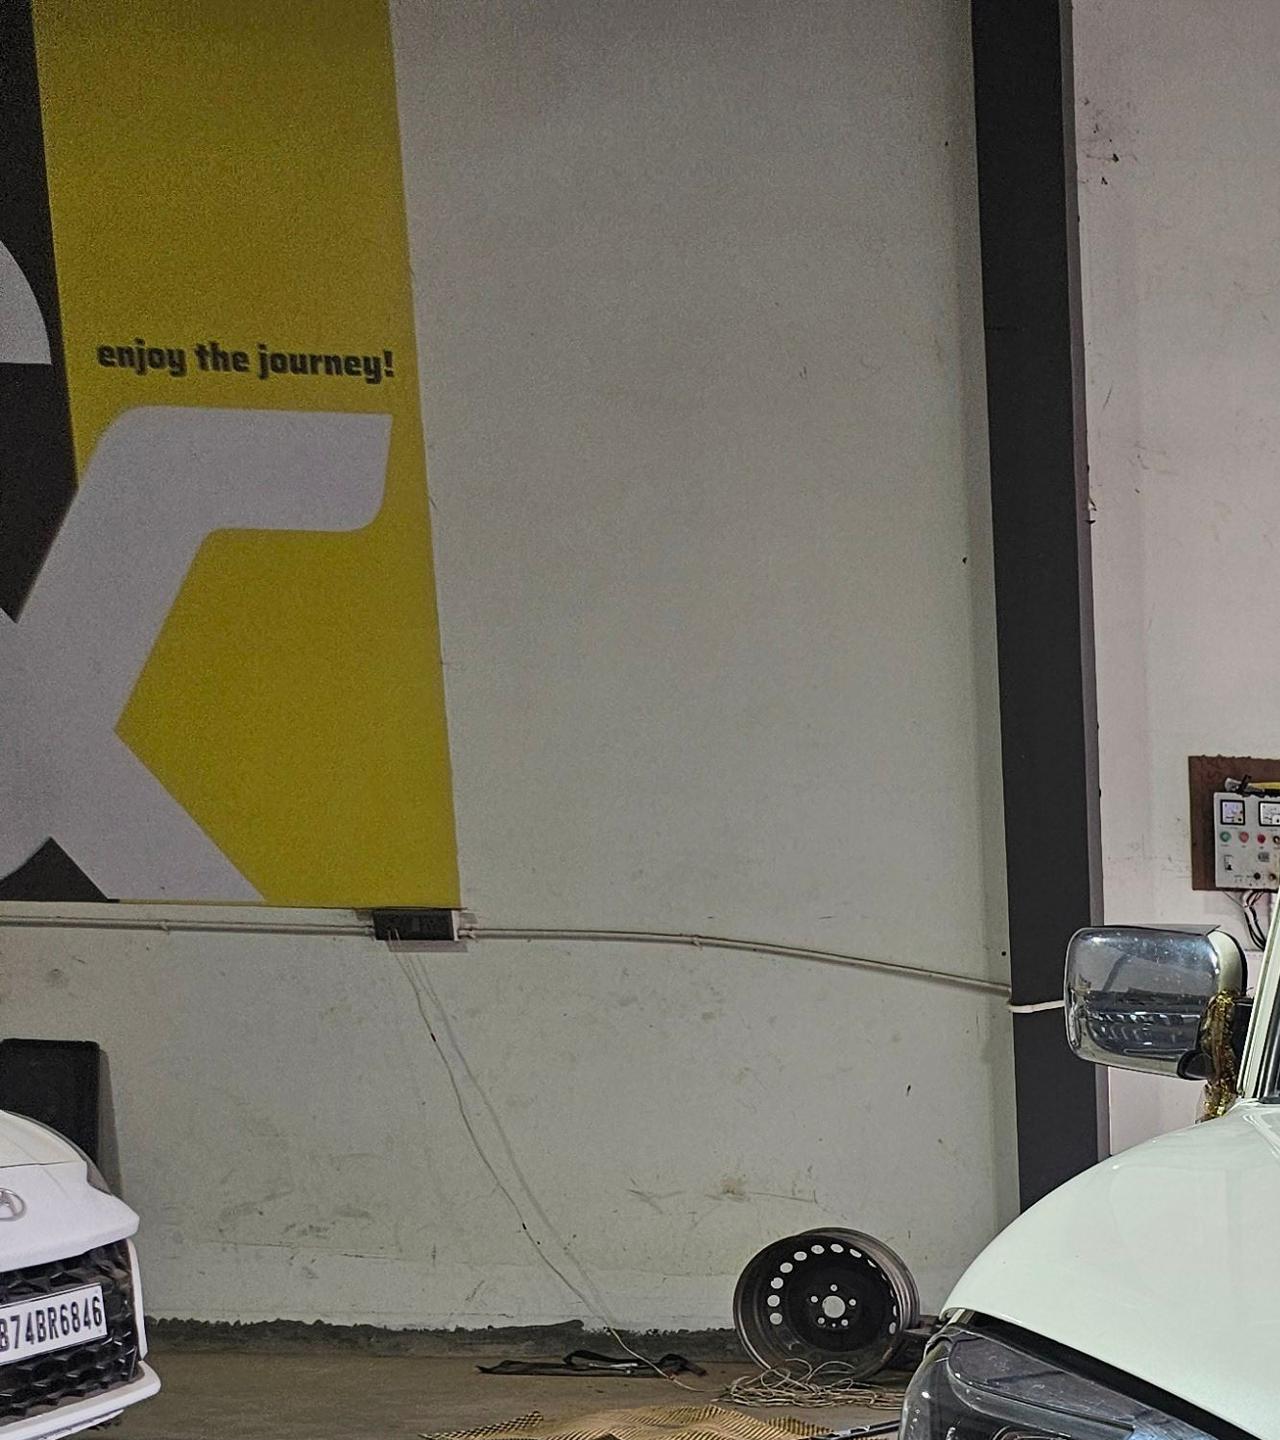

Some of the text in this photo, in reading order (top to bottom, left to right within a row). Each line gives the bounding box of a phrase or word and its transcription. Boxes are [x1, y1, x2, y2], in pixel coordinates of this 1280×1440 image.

[97, 338, 395, 385] enjoy the journey!
